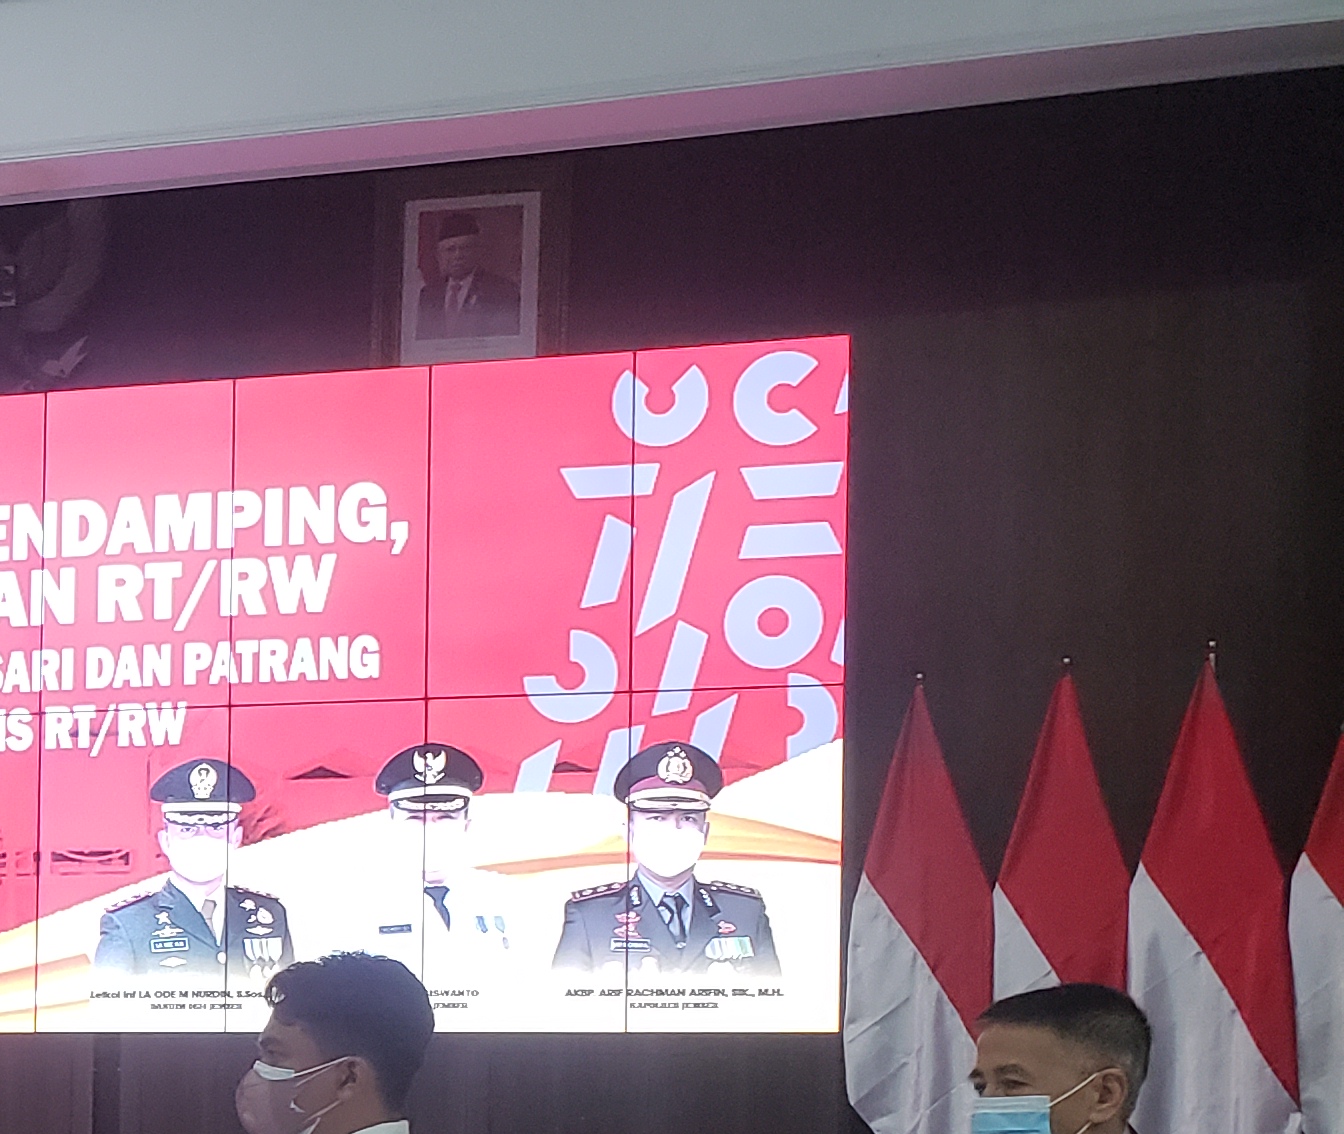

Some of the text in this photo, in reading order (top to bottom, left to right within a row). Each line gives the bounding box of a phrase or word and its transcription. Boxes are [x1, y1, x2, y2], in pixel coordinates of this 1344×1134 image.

[96, 553, 337, 631] RT/RW
[86, 642, 172, 689] DAN
[183, 635, 380, 685] PATRANG
[44, 701, 188, 758] RT/RW
[154, 991, 176, 999] ODE
